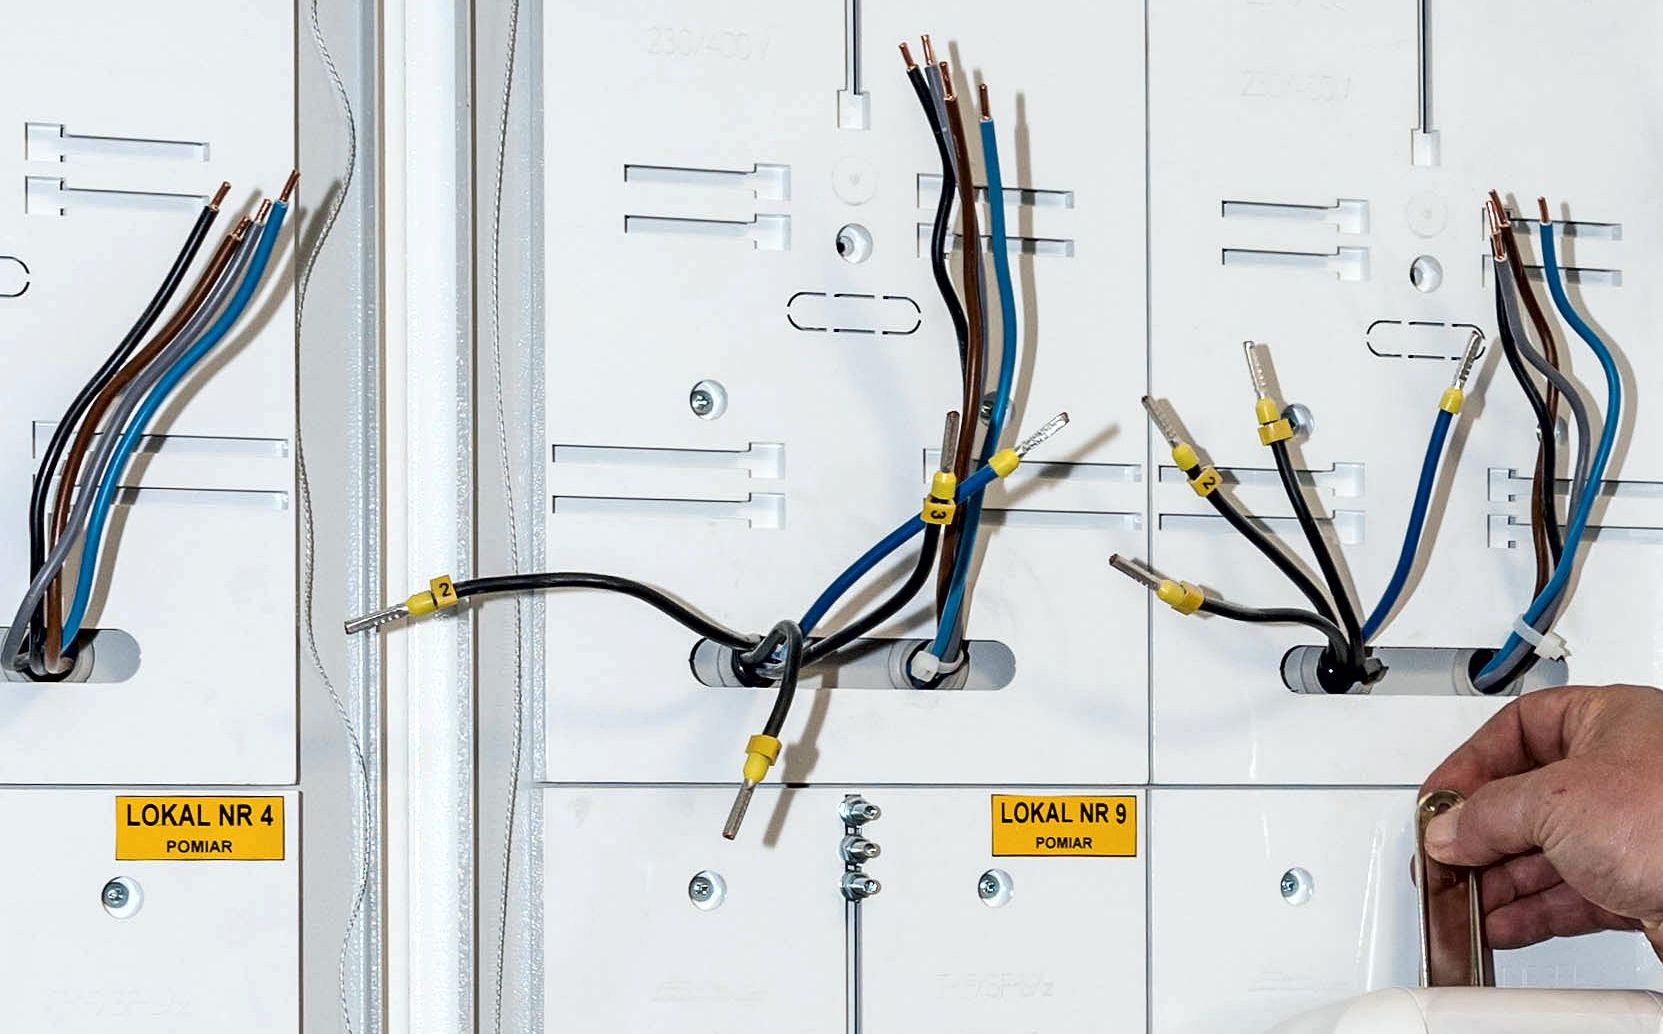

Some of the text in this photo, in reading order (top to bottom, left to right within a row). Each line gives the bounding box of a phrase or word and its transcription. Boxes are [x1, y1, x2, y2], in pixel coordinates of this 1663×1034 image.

[1202, 476, 1216, 490] 2
[930, 510, 946, 520] 3
[438, 582, 451, 597] 2
[127, 803, 274, 826] LOKAL NR 4
[1001, 802, 1127, 824] LOKAL NR 9
[166, 840, 233, 853] POMIAR
[1036, 836, 1093, 849] POMIAR
